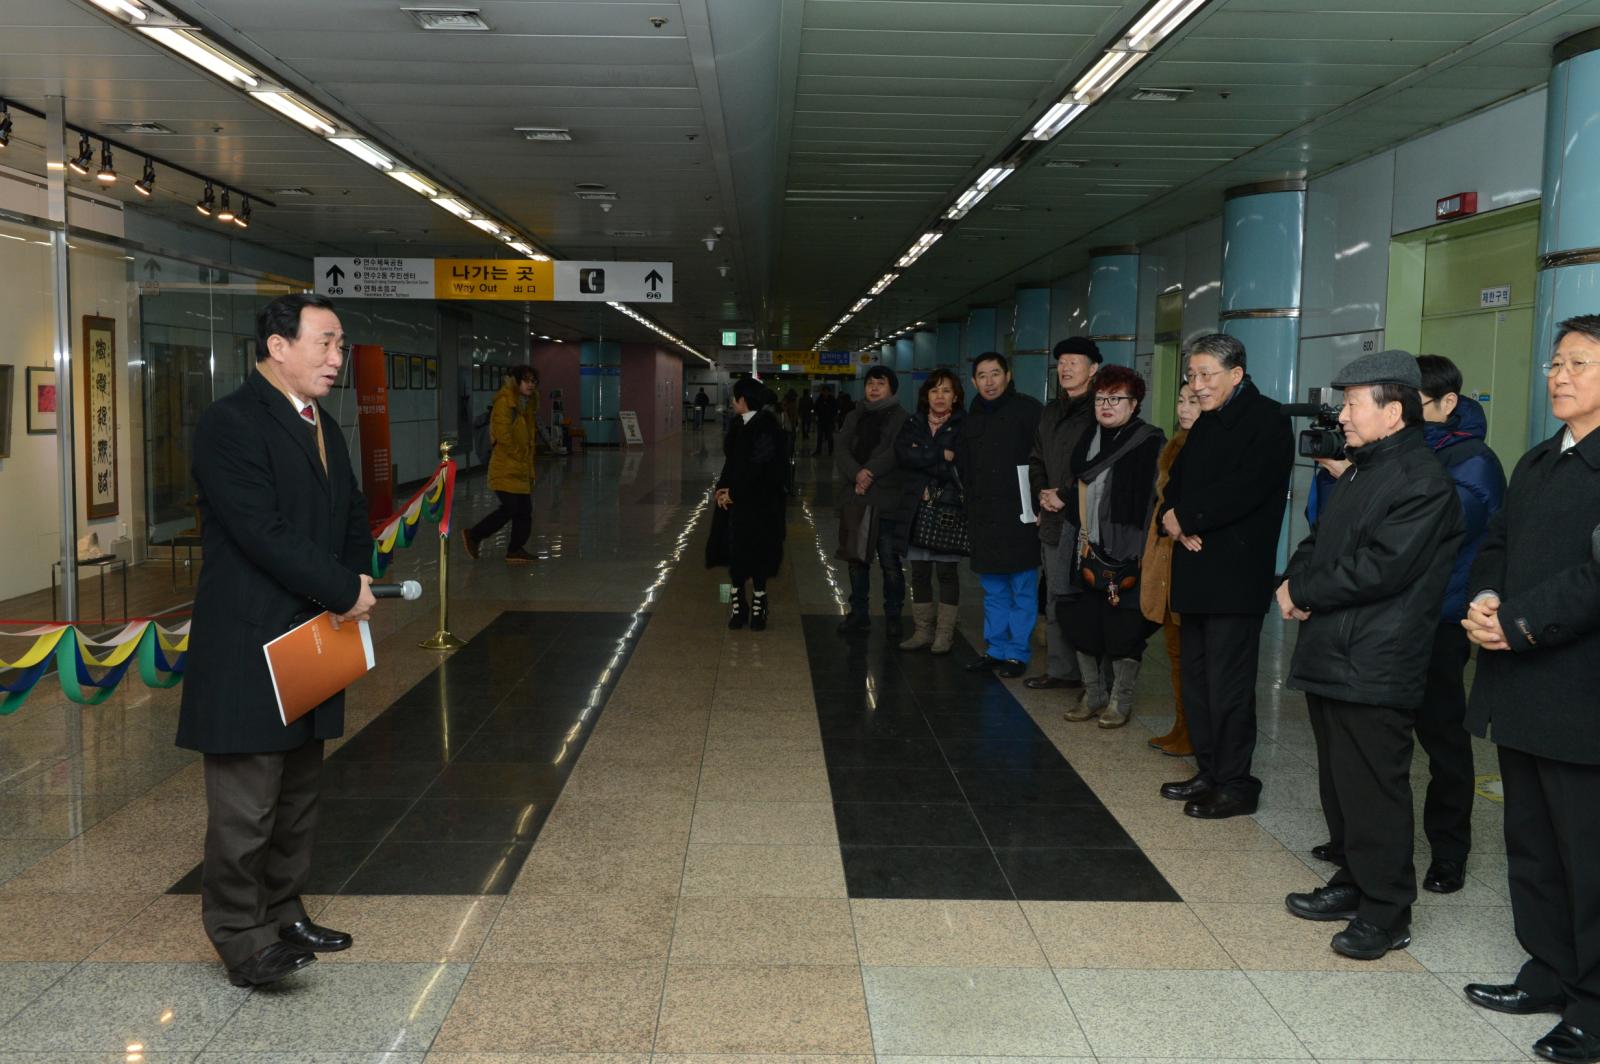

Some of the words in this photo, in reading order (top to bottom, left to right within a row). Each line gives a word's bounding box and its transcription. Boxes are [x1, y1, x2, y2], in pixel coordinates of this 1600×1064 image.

[363, 272, 388, 280] 연수2동
[389, 272, 416, 280] 주민센터
[452, 265, 508, 281] 나가는
[516, 265, 534, 281] 곳
[453, 283, 475, 295] Way
[479, 283, 497, 294] Out
[1482, 290, 1508, 304] 제한구역
